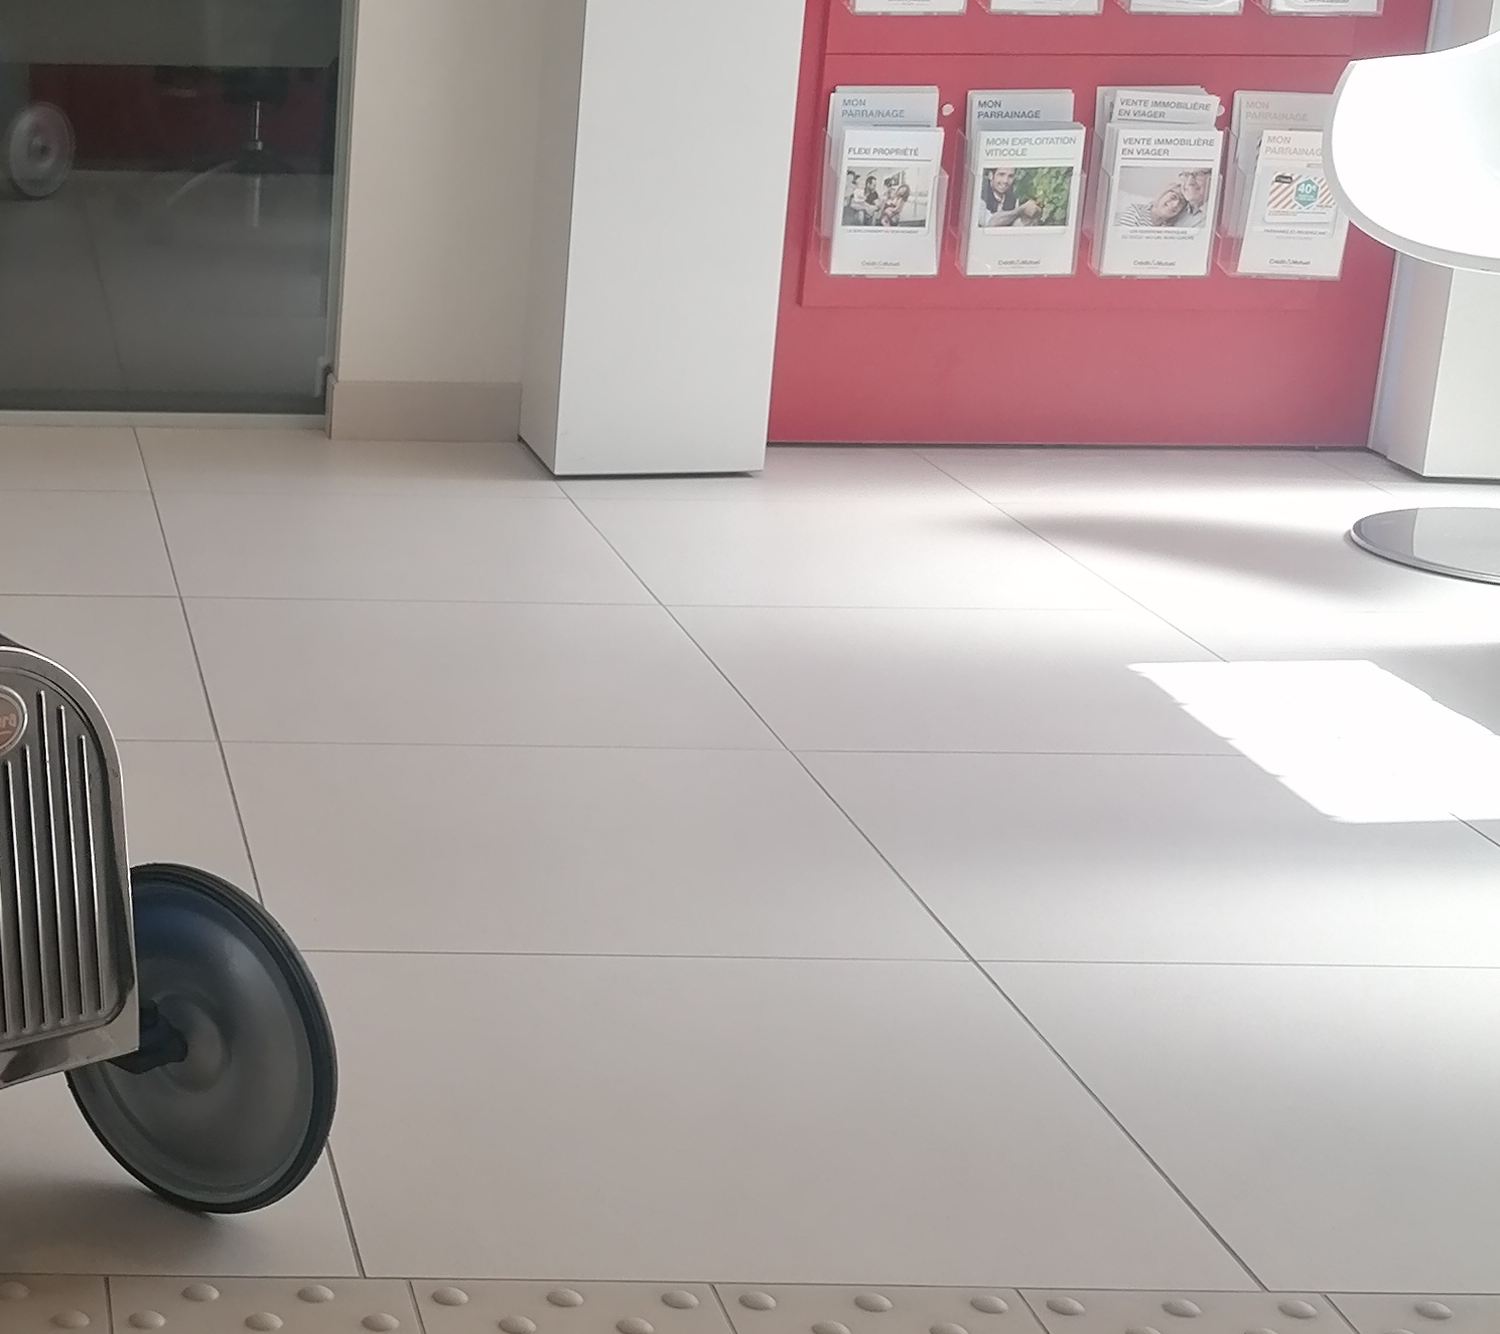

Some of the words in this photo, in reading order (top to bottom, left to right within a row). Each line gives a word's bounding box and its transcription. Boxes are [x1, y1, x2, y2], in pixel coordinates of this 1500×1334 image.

[842, 98, 866, 107] MON
[978, 100, 1002, 108] MON
[1120, 98, 1149, 107] VENTE
[1150, 99, 1211, 112] IMMOBILIÈRE
[1246, 101, 1269, 109] MON
[841, 109, 905, 118] PARRAINAGE
[977, 110, 1041, 119] PARRAINAGE
[1118, 108, 1130, 117] EN
[1131, 110, 1166, 119] VIAGER
[986, 137, 1009, 146] MON
[1011, 136, 1077, 146] EXPLOITATION
[1122, 137, 1152, 146] VENTE
[1153, 136, 1215, 147] IMMOBILIÈRE
[1267, 135, 1291, 144] MON
[848, 147, 871, 155] FLEXI
[872, 146, 919, 156] PROPRIÉTÉ
[985, 147, 1028, 157] VITICOLE
[1121, 147, 1133, 156] EN
[1134, 147, 1170, 156] VIAGER
[1264, 146, 1323, 157] PARRAINAG
